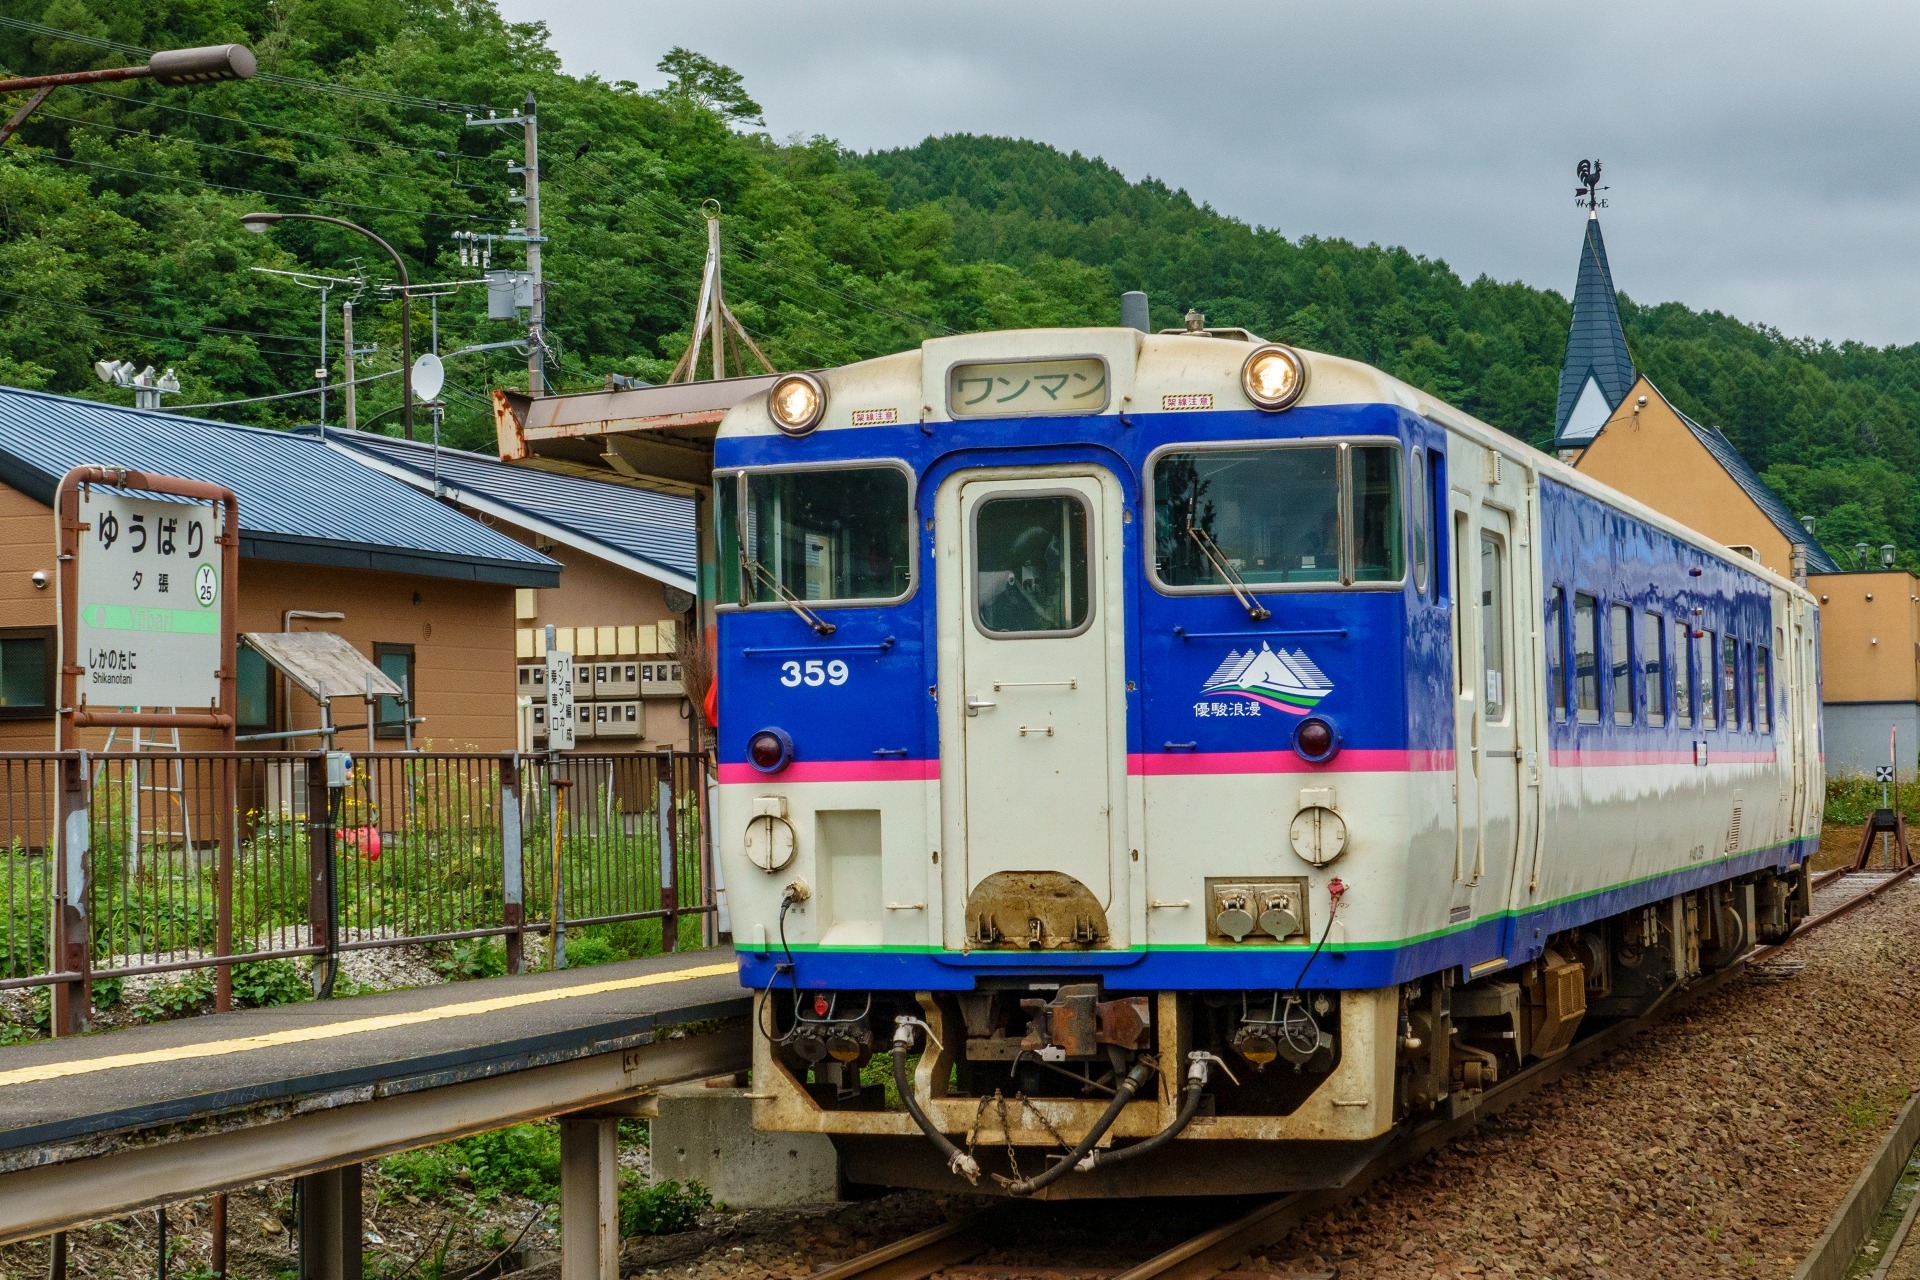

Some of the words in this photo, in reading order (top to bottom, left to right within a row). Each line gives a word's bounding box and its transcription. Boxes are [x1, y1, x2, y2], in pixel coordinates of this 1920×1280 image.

[1575, 199, 1584, 208] W
[1602, 199, 1609, 208] E
[957, 372, 1106, 406] ワンマン
[1167, 396, 1209, 407] 架線注意
[99, 510, 203, 558] ゆうばり
[132, 570, 170, 594] 夕張
[203, 569, 210, 583] Y
[200, 586, 212, 600] 25
[89, 647, 137, 671] しかのたに
[92, 671, 133, 685] Shikanotani
[780, 659, 849, 687] 359
[1193, 702, 1261, 717] 優駿浪漫
